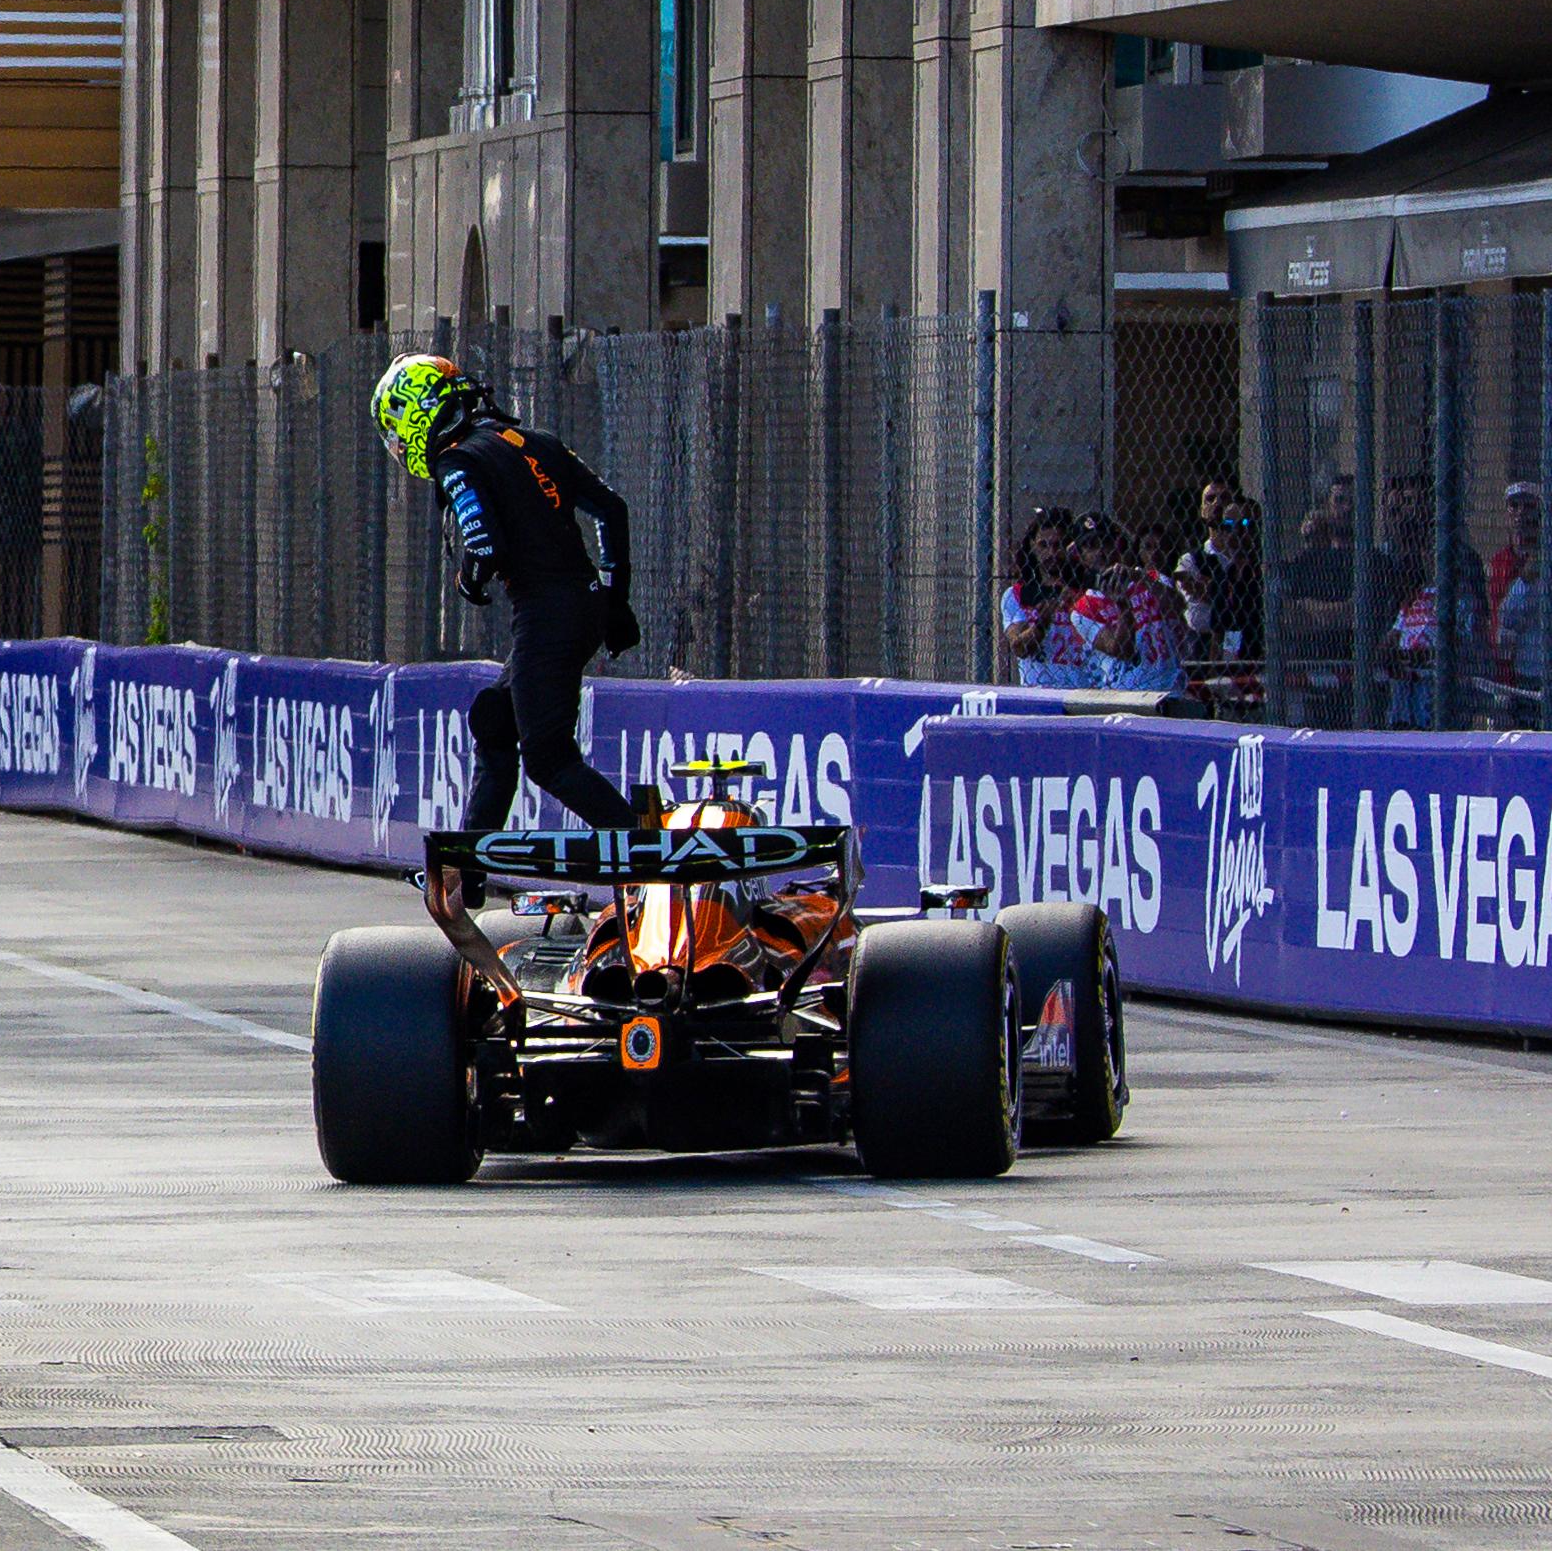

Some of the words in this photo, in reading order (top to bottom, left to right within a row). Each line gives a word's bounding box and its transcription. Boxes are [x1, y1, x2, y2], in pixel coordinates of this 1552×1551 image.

[109, 679, 140, 786] LAS
[140, 683, 197, 798] VEGAS
[252, 695, 289, 811] LAS
[292, 699, 353, 824] VEGAS
[417, 708, 463, 830] LAS
[474, 830, 809, 875] ETIHAD
[919, 773, 1003, 922] LAS
[1010, 773, 1162, 934] VEGAS
[1316, 786, 1419, 958] LAS
[1039, 1033, 1070, 1068] intel
